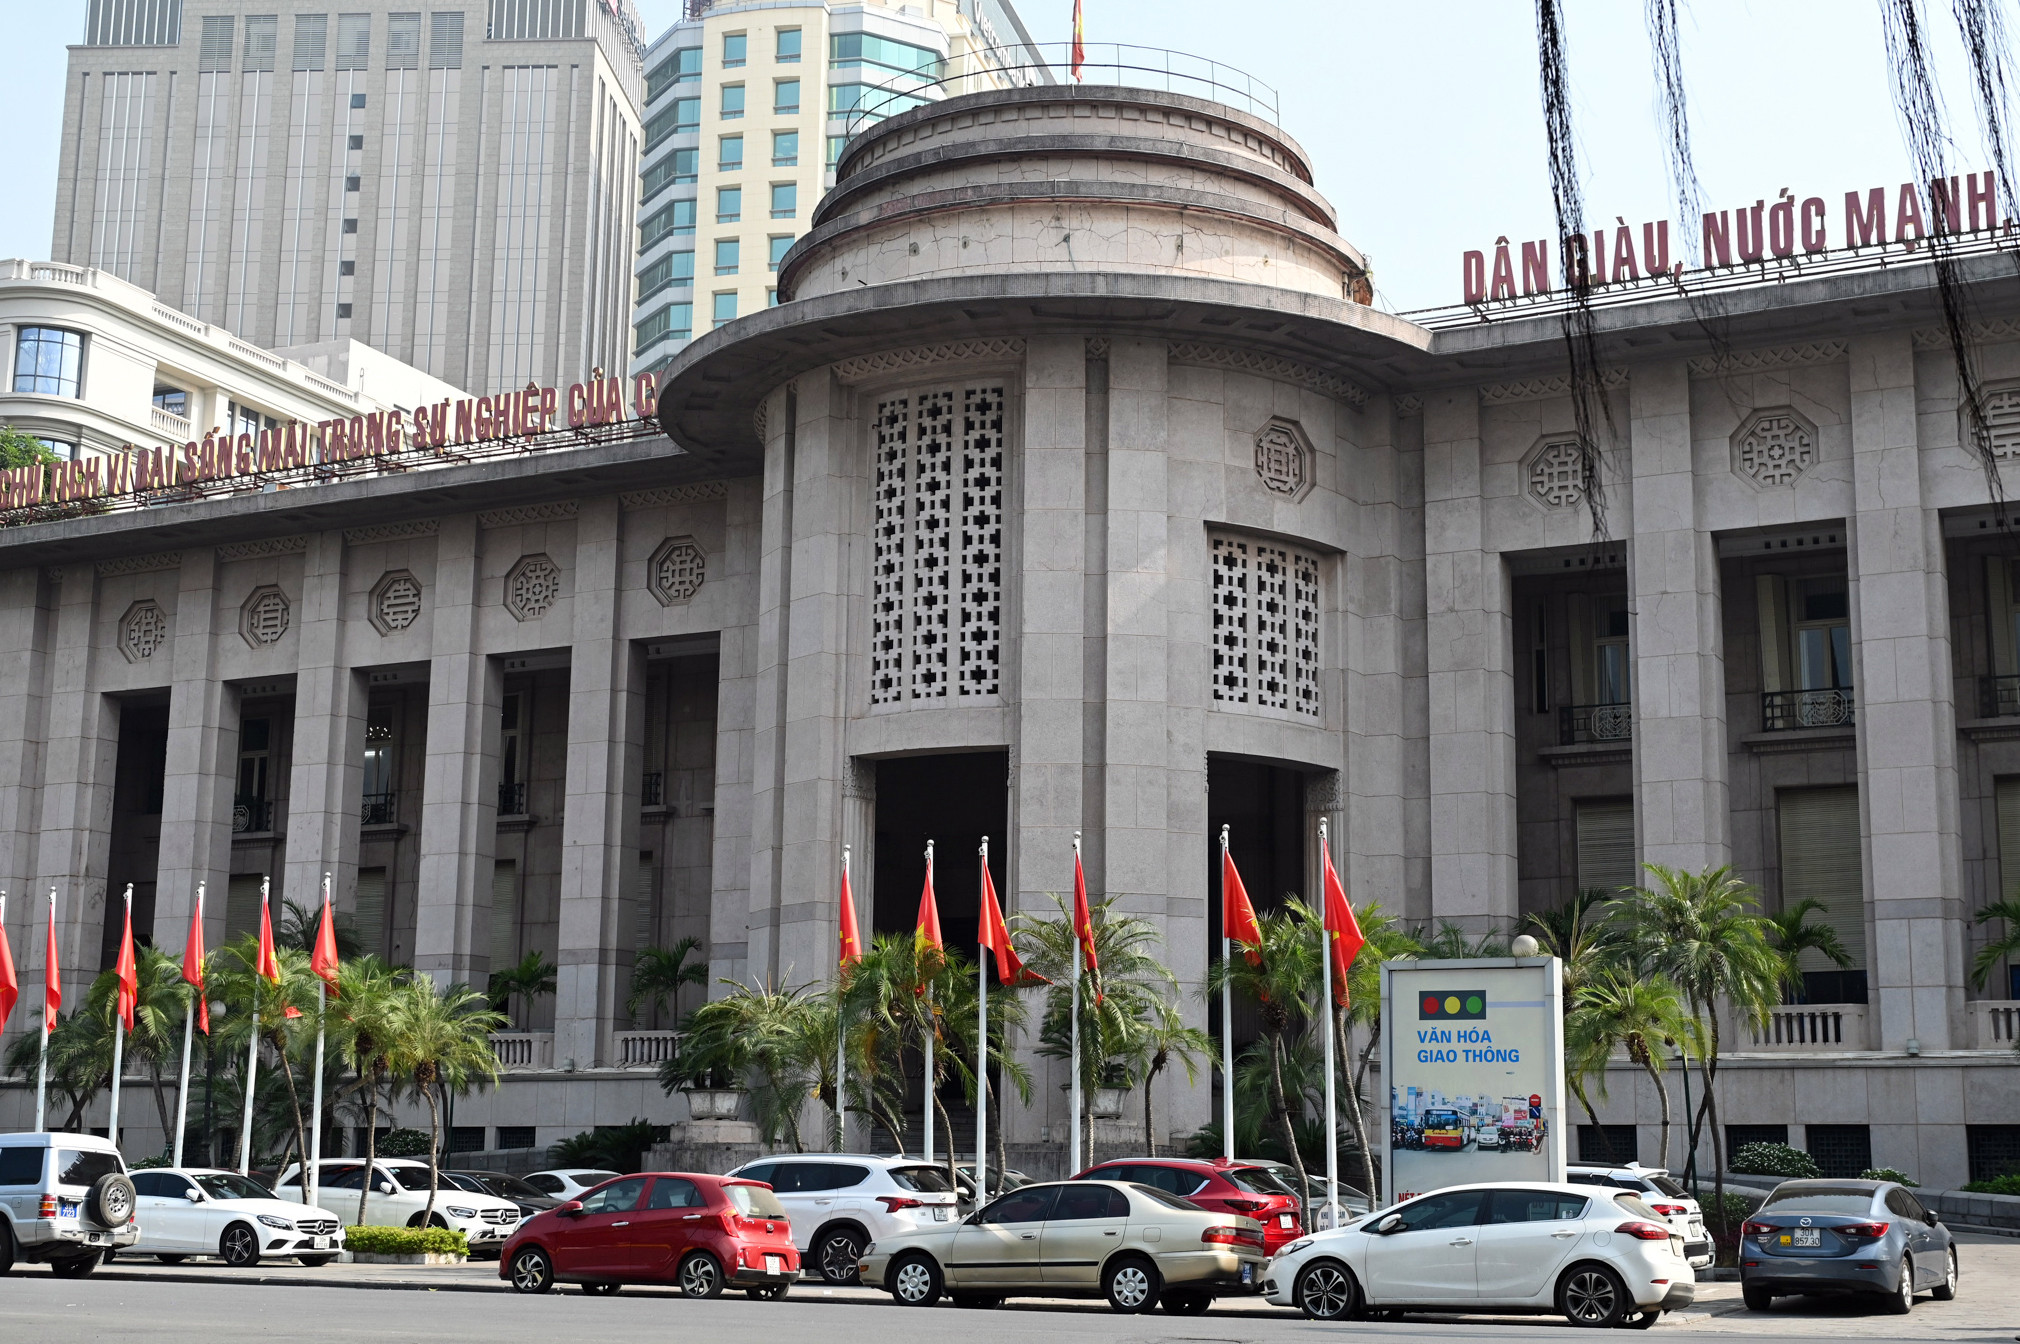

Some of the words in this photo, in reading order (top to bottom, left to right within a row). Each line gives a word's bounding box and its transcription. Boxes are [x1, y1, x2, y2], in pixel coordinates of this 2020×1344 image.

[1463, 236, 1550, 304] DÂN
[1702, 187, 1827, 268] NƯỚC
[50, 456, 102, 509] TỊCH
[135, 443, 178, 495] ĐẠI
[183, 426, 255, 482] SỐNG
[258, 418, 311, 472] MÃI
[318, 410, 404, 463] TRONG
[413, 398, 452, 454] SỰ
[455, 381, 559, 443] NGHIỆP
[568, 366, 626, 427] CỦA
[1417, 1026, 1452, 1044] VĂN
[1457, 1026, 1492, 1044] HÓA
[1417, 1049, 1458, 1063] GIAO
[1462, 1045, 1520, 1063] THÔNG
[1800, 1228, 1815, 1237] 30A
